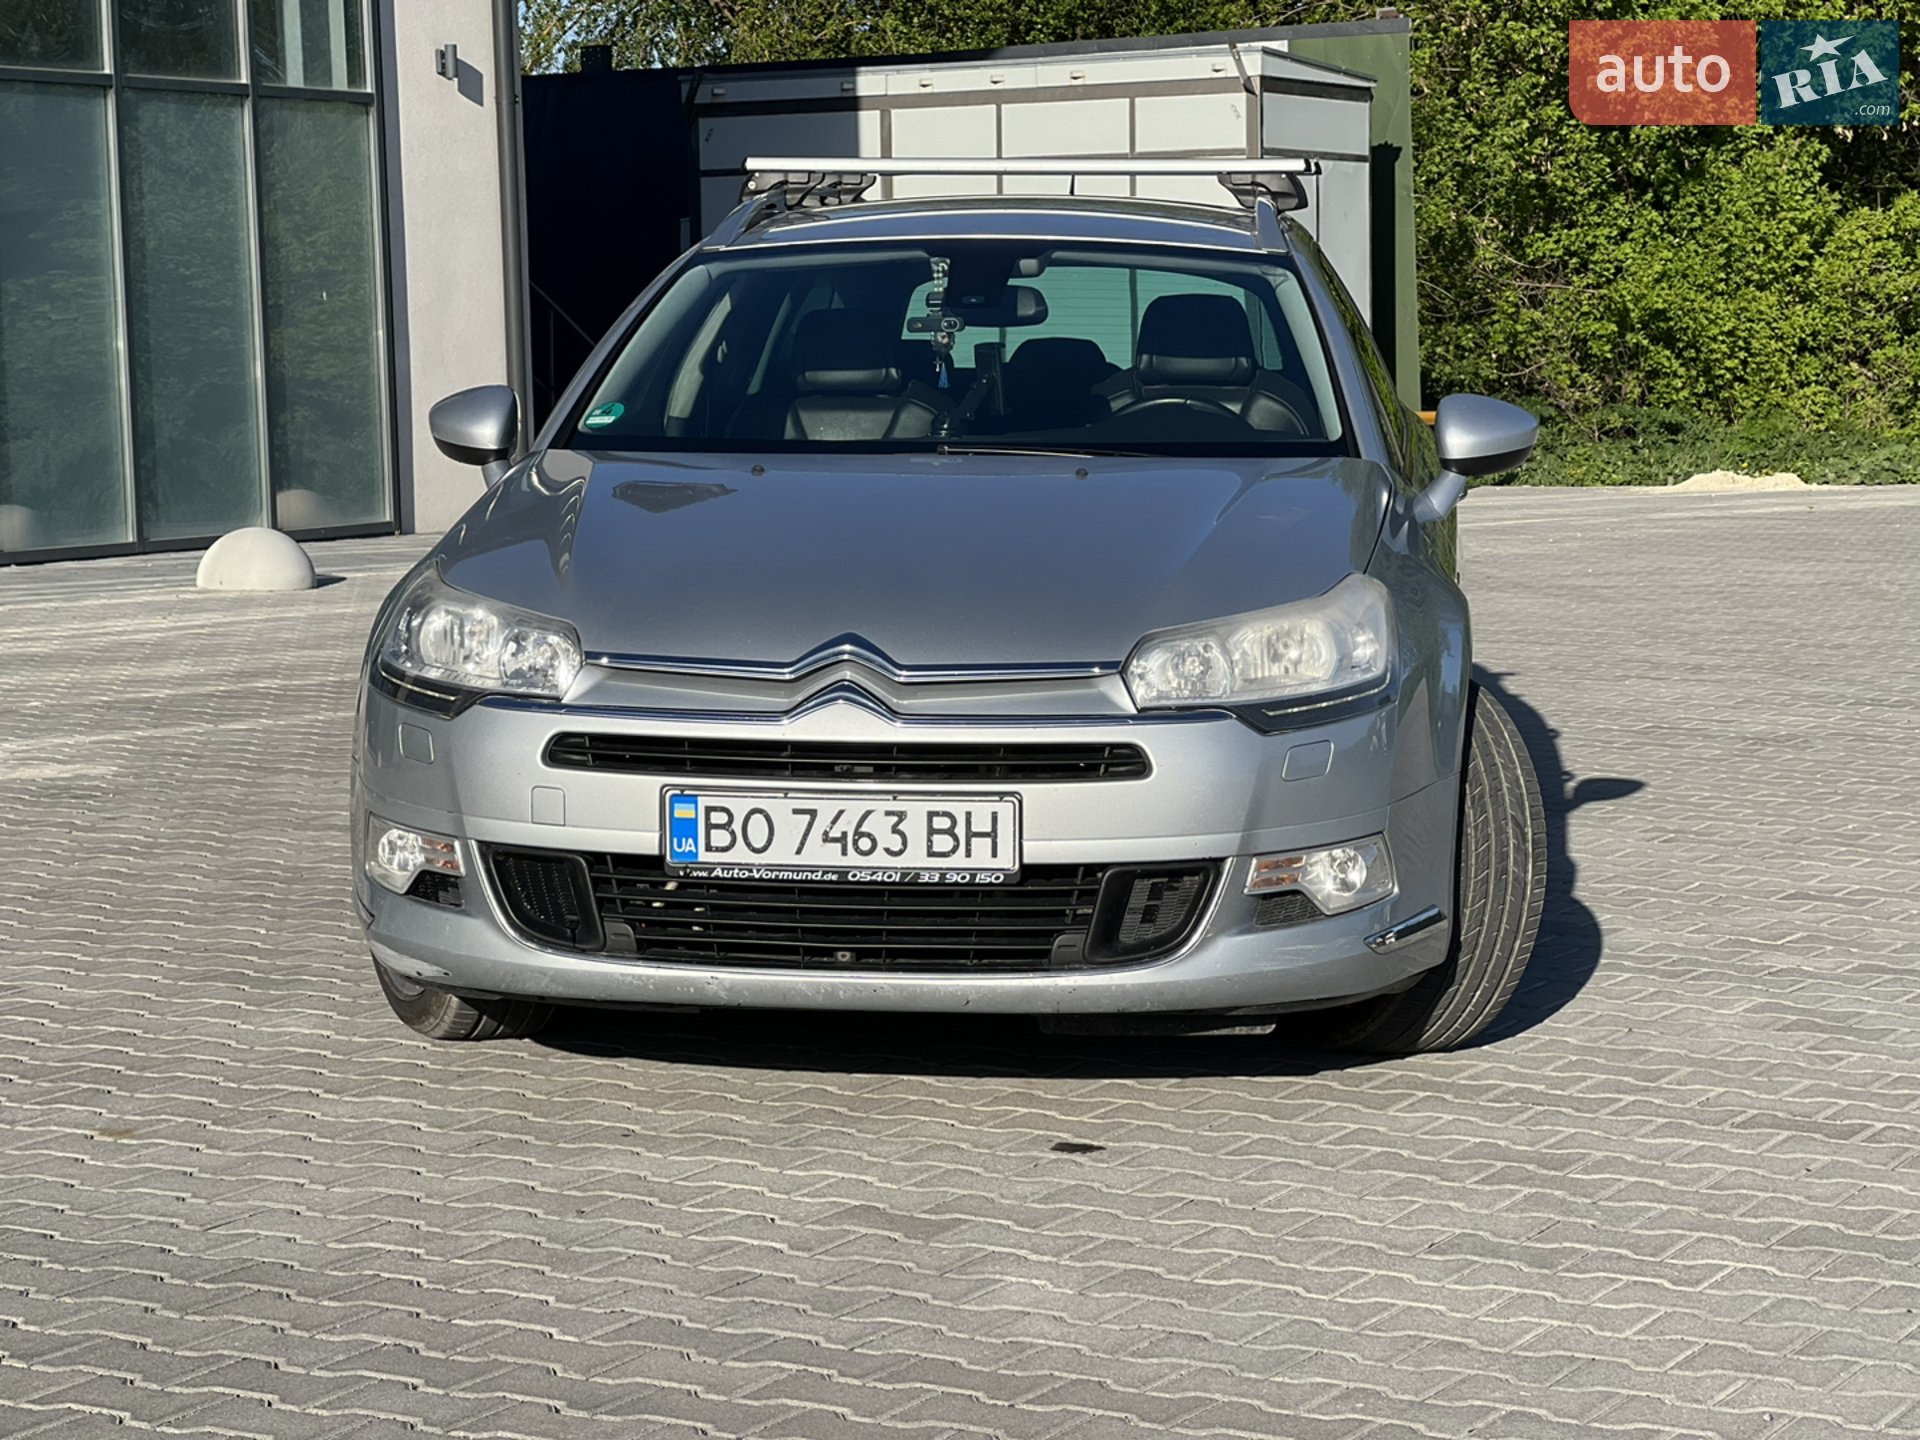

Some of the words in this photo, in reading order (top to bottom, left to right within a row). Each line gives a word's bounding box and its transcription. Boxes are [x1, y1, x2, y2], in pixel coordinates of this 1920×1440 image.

[703, 805, 776, 855] BO
[791, 807, 909, 857] 7463
[926, 810, 998, 859] BH
[672, 836, 697, 854] UA
[847, 870, 901, 883] 05401
[917, 872, 941, 884] 33
[944, 872, 970, 884] 90
[974, 872, 1005, 884] 150
